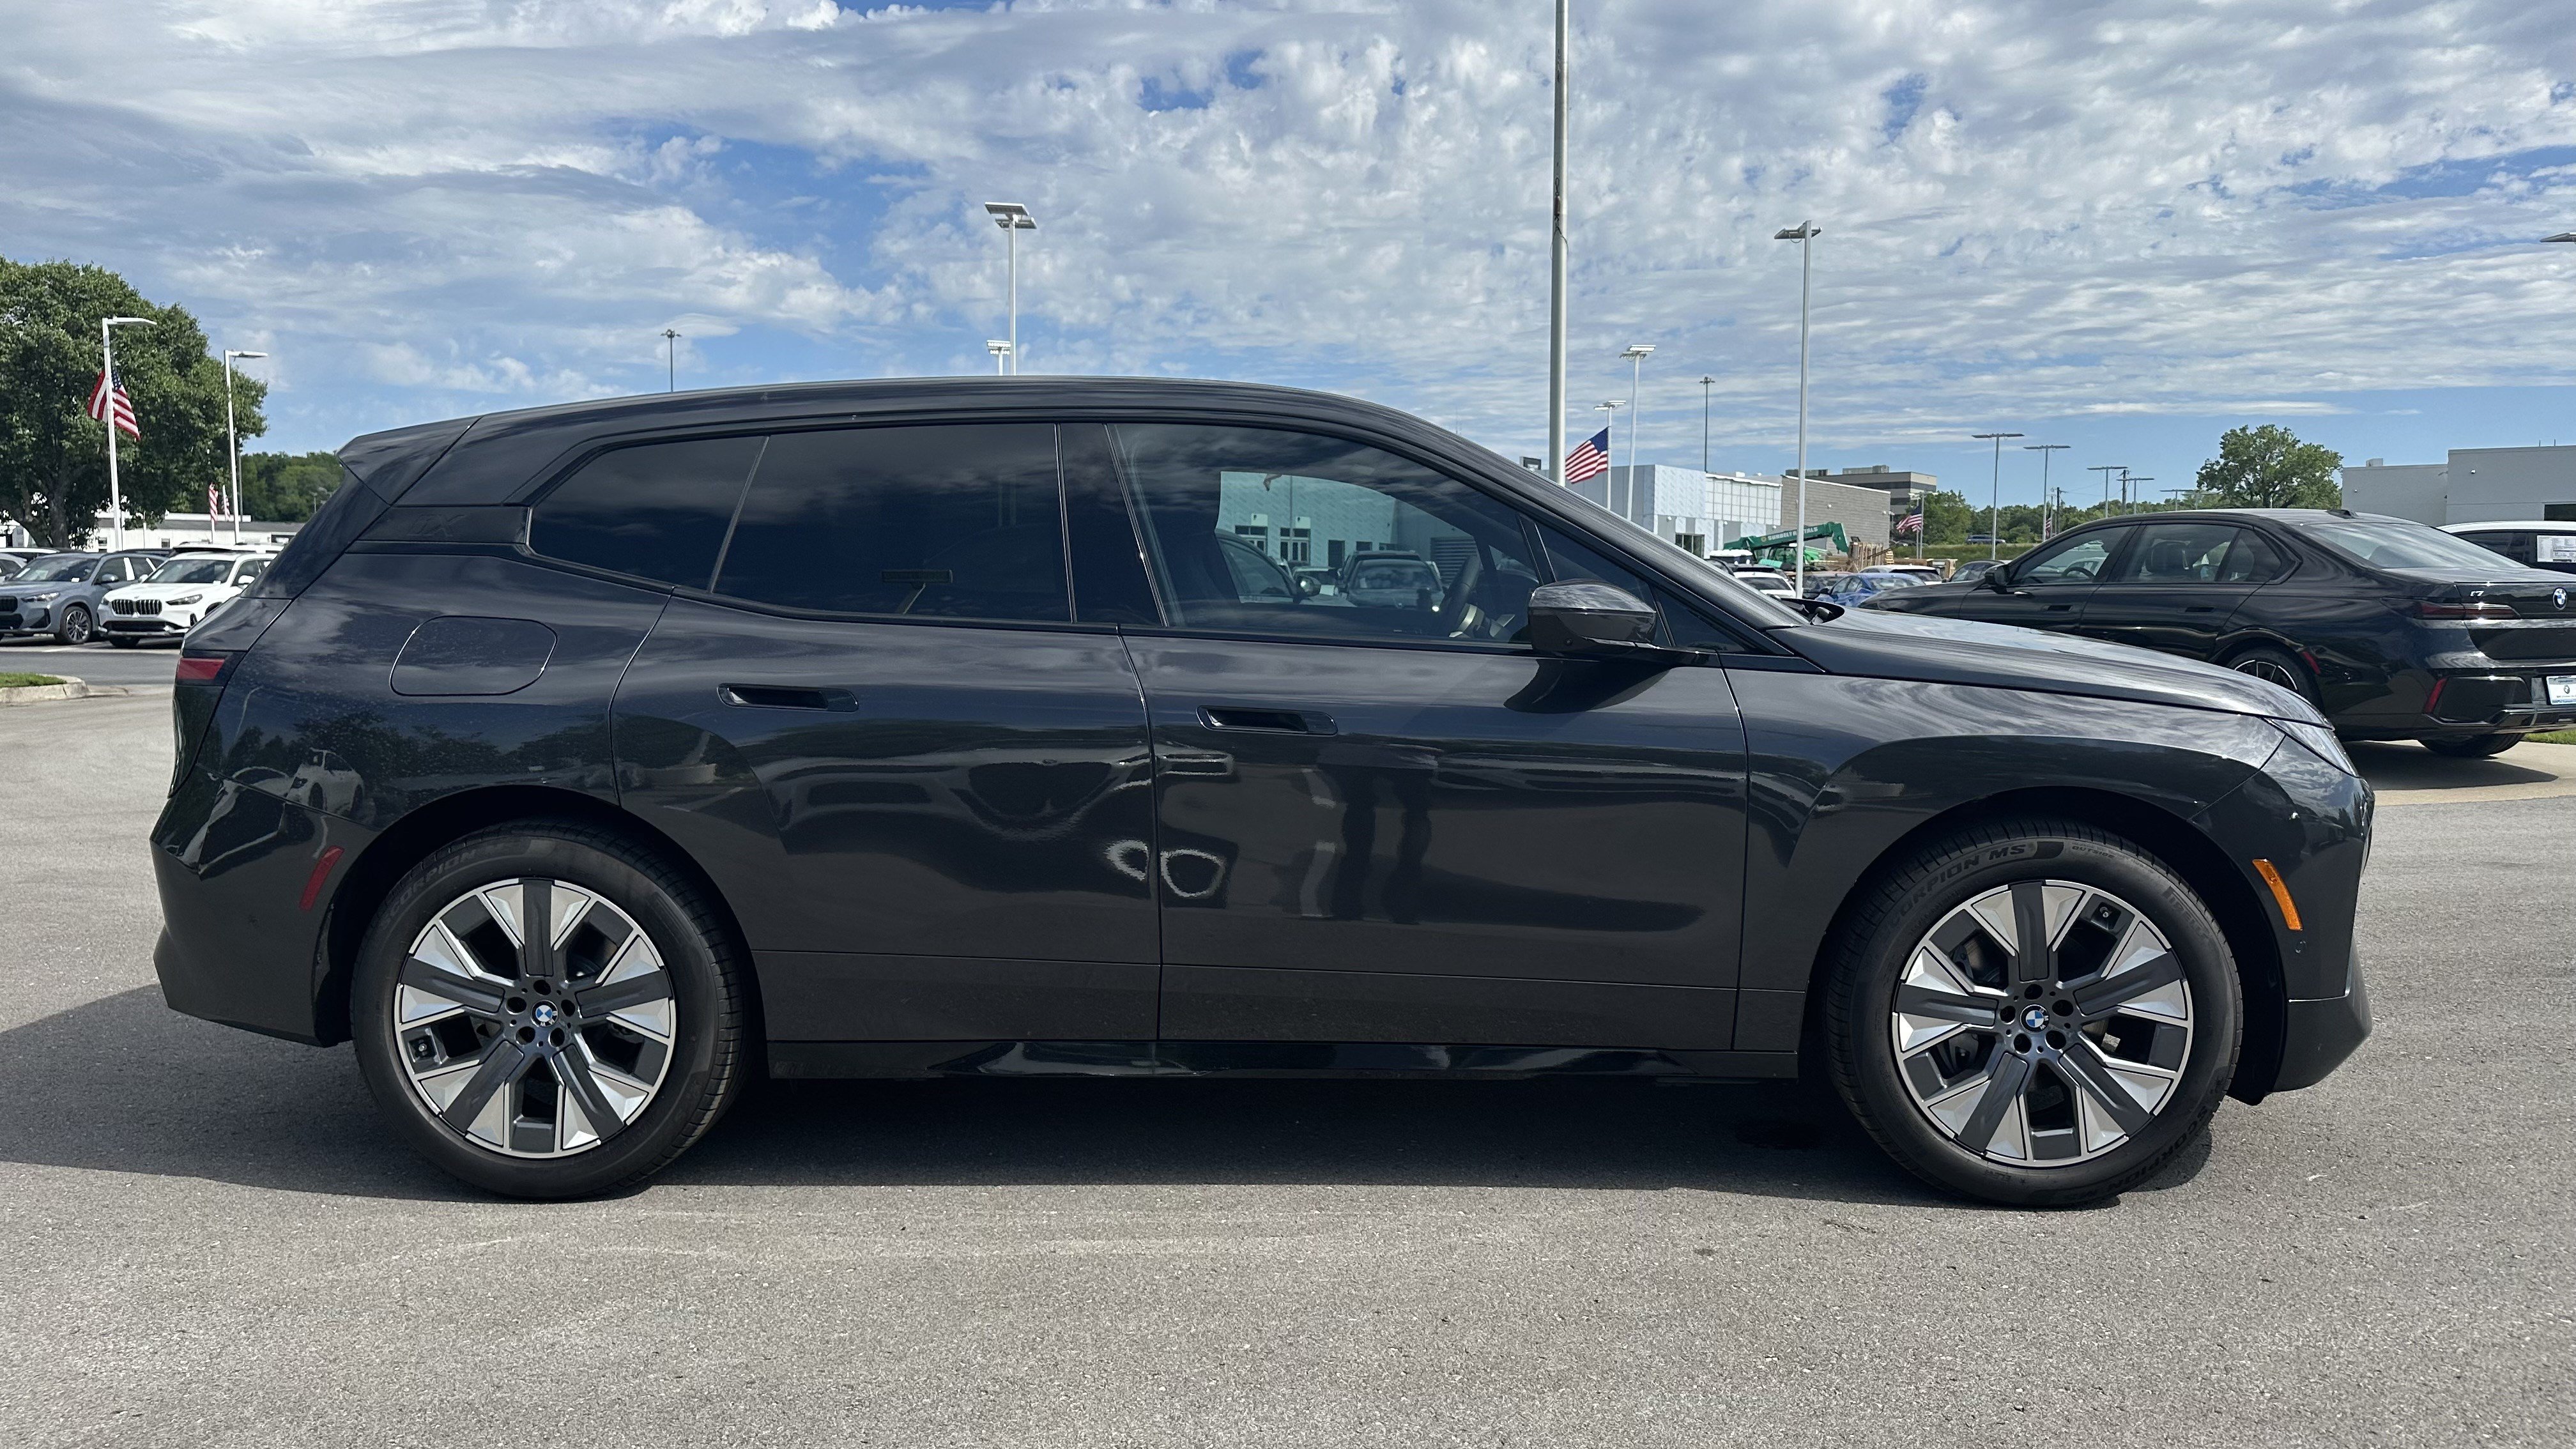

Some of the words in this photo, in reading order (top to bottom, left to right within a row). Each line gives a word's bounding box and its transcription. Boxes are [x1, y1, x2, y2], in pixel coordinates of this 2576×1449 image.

[1768, 532, 1793, 540] SUNBELT
[1793, 527, 1818, 536] RTALS
[1988, 844, 2026, 861] MS
[2071, 845, 2115, 858] OUTSIDE
[540, 1011, 558, 1027] BMW
